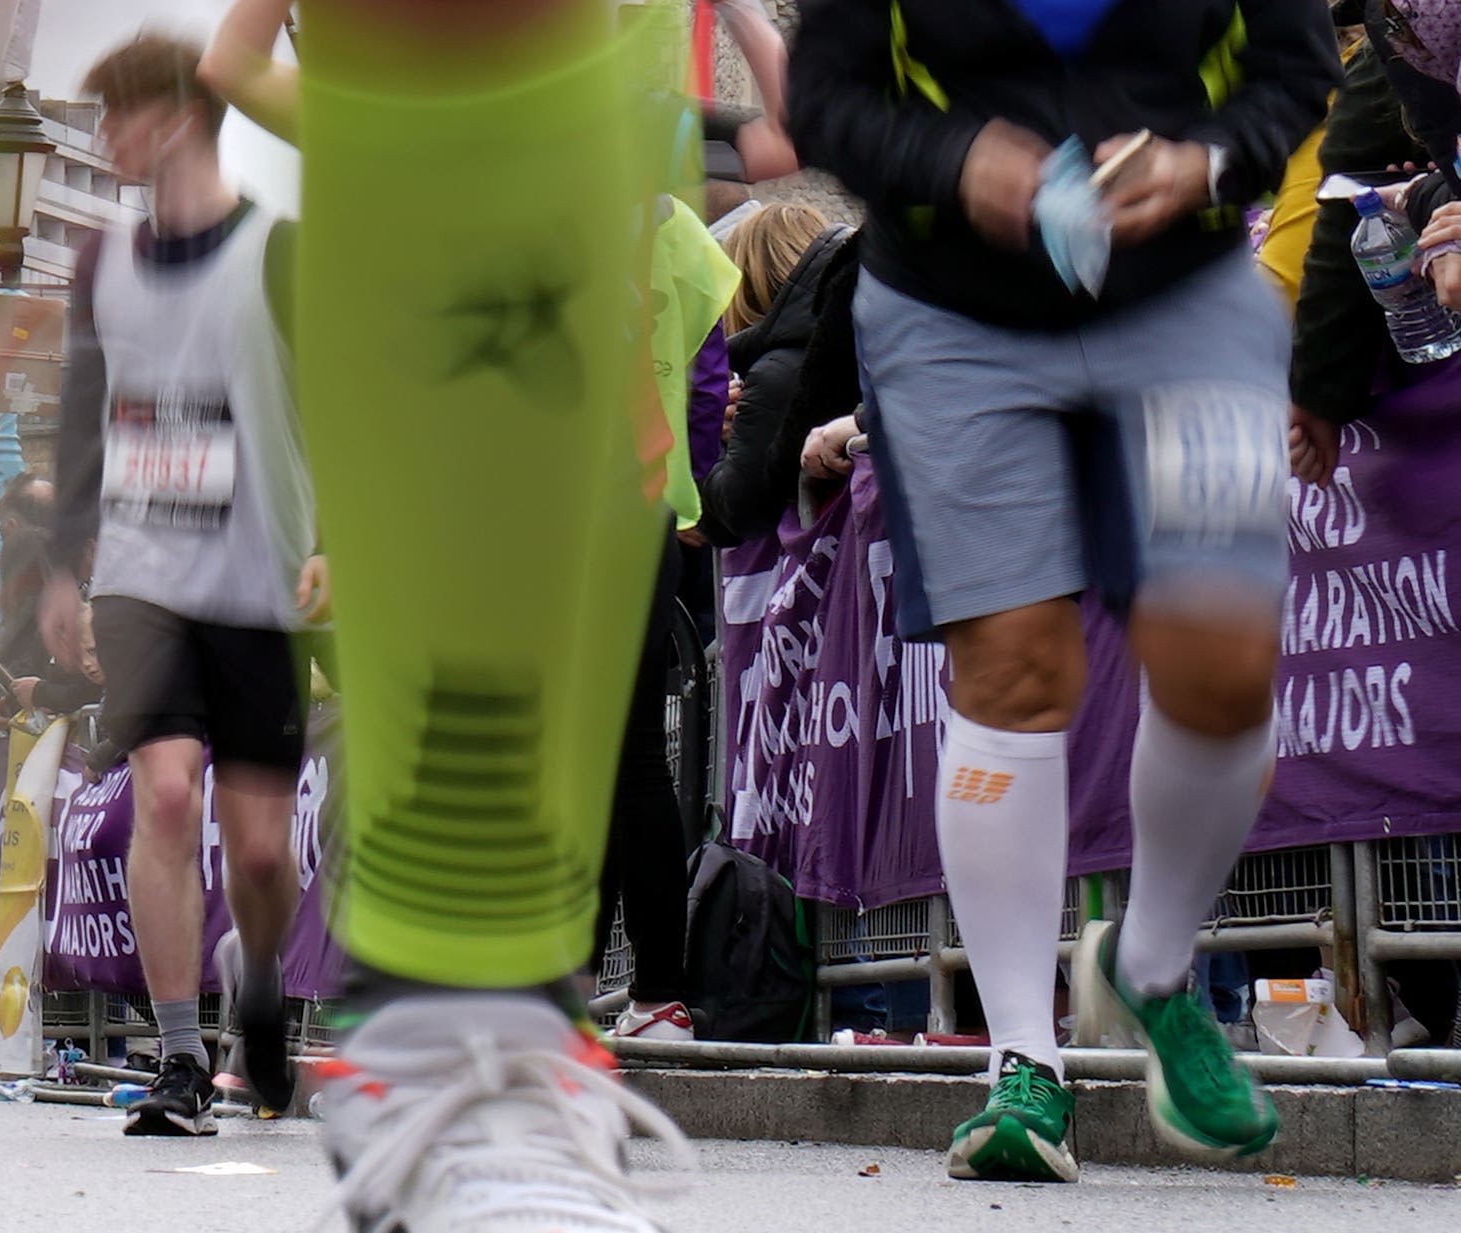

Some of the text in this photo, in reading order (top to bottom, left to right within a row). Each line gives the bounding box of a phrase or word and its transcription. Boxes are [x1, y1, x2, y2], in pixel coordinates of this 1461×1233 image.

[1281, 550, 1460, 656] MARATHON
[1276, 662, 1416, 758] MAJORS
[63, 856, 127, 905] MARATH
[59, 900, 136, 958] MAJORS
